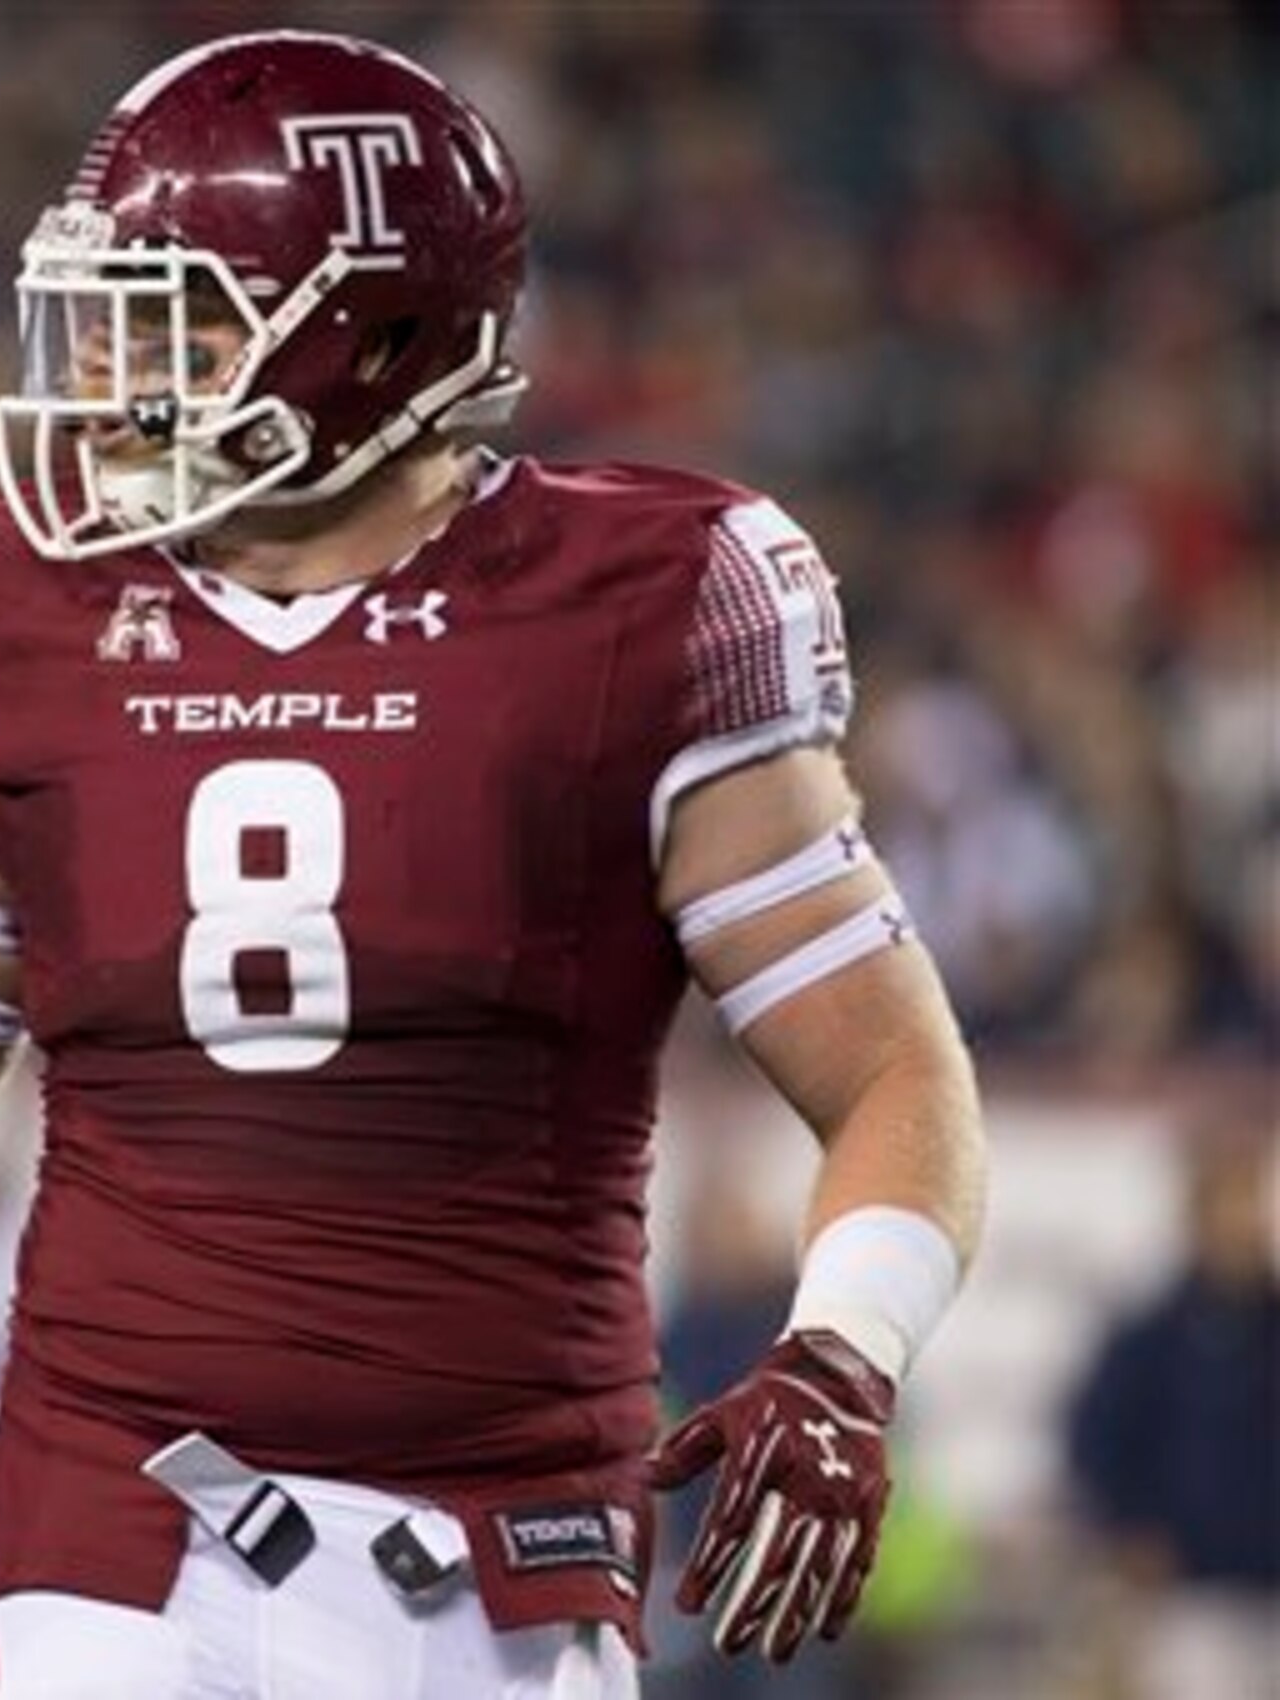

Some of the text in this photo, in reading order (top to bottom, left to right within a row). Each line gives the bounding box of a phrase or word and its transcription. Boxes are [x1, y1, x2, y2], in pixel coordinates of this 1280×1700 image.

[280, 115, 422, 270] T
[126, 693, 417, 732] TEMPLE
[180, 758, 351, 1073] 8
